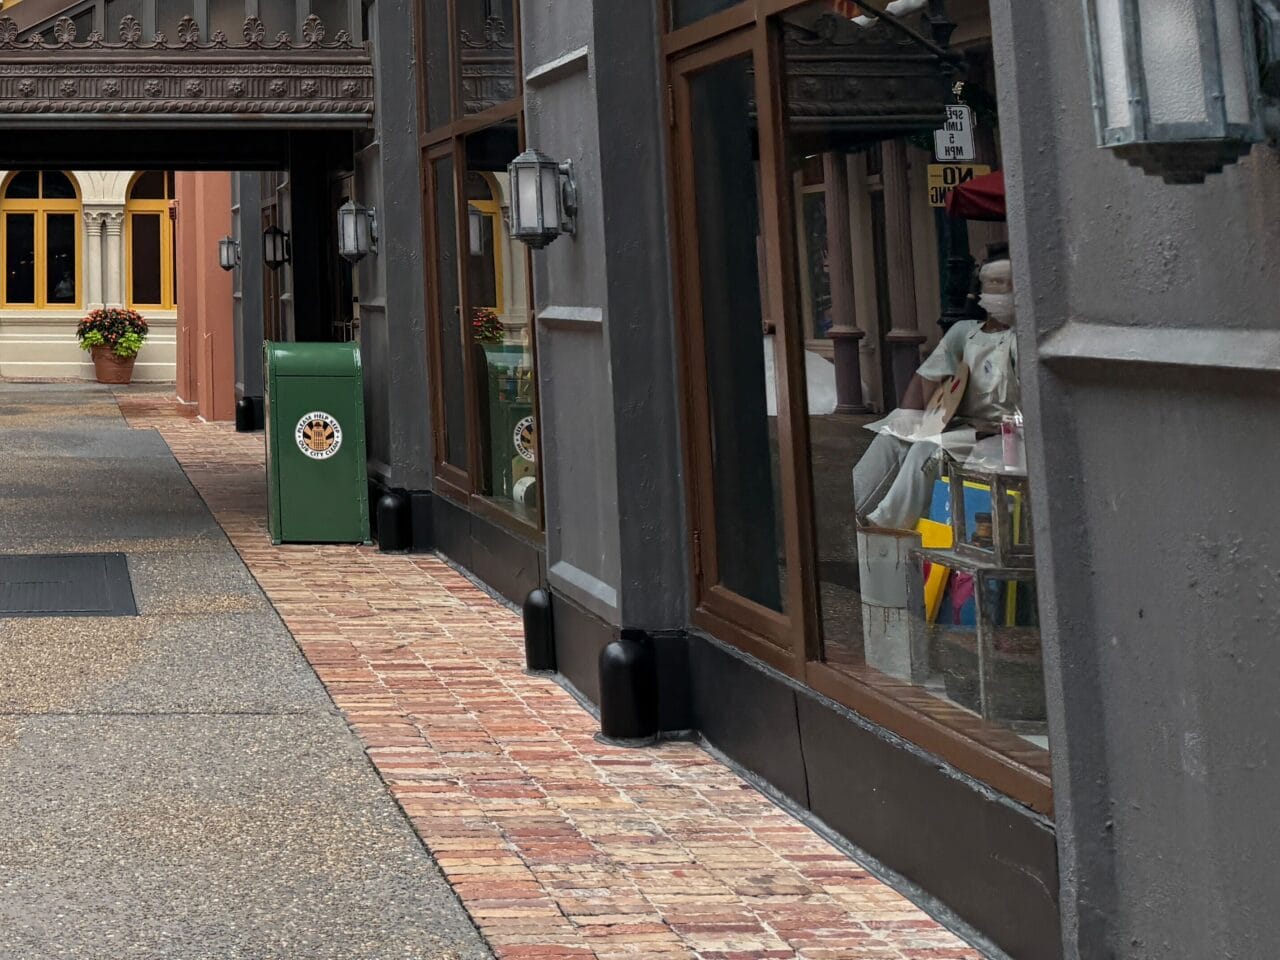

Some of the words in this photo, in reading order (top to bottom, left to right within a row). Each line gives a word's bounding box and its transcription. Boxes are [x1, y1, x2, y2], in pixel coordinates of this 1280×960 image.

[297, 415, 312, 434] PLEASE
[329, 419, 340, 434] KEEP
[325, 440, 339, 456] CLEAN
